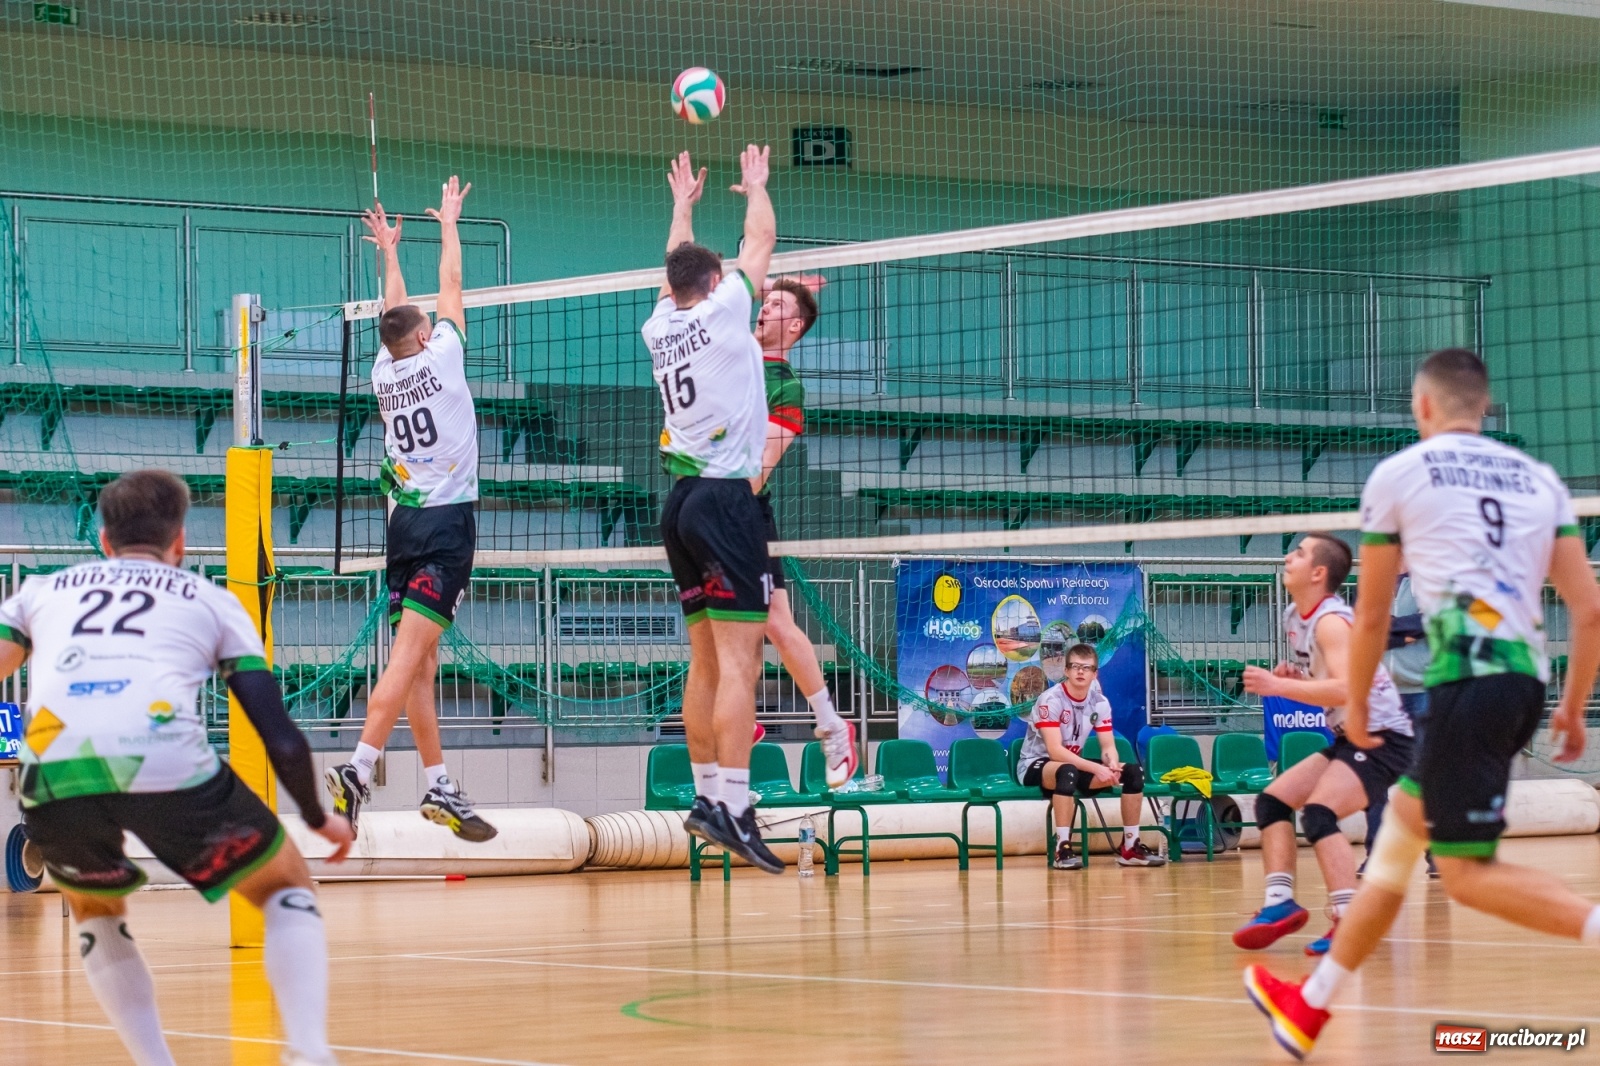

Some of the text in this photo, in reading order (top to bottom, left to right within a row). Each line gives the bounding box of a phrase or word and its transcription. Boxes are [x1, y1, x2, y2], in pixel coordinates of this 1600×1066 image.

[804, 141, 836, 161] D
[652, 329, 711, 370] UDZINIEC
[378, 376, 443, 412] RUDZINIEC
[661, 363, 697, 415] 15
[393, 407, 438, 453] 99
[1480, 497, 1504, 548] 9
[53, 571, 198, 601] RUDZINIEC
[973, 576, 1110, 591] Ośrodek Sportu i Rekreacji
[1047, 594, 1110, 606] w Raciborzu
[71, 589, 156, 638] 22
[1272, 710, 1327, 729] molten
